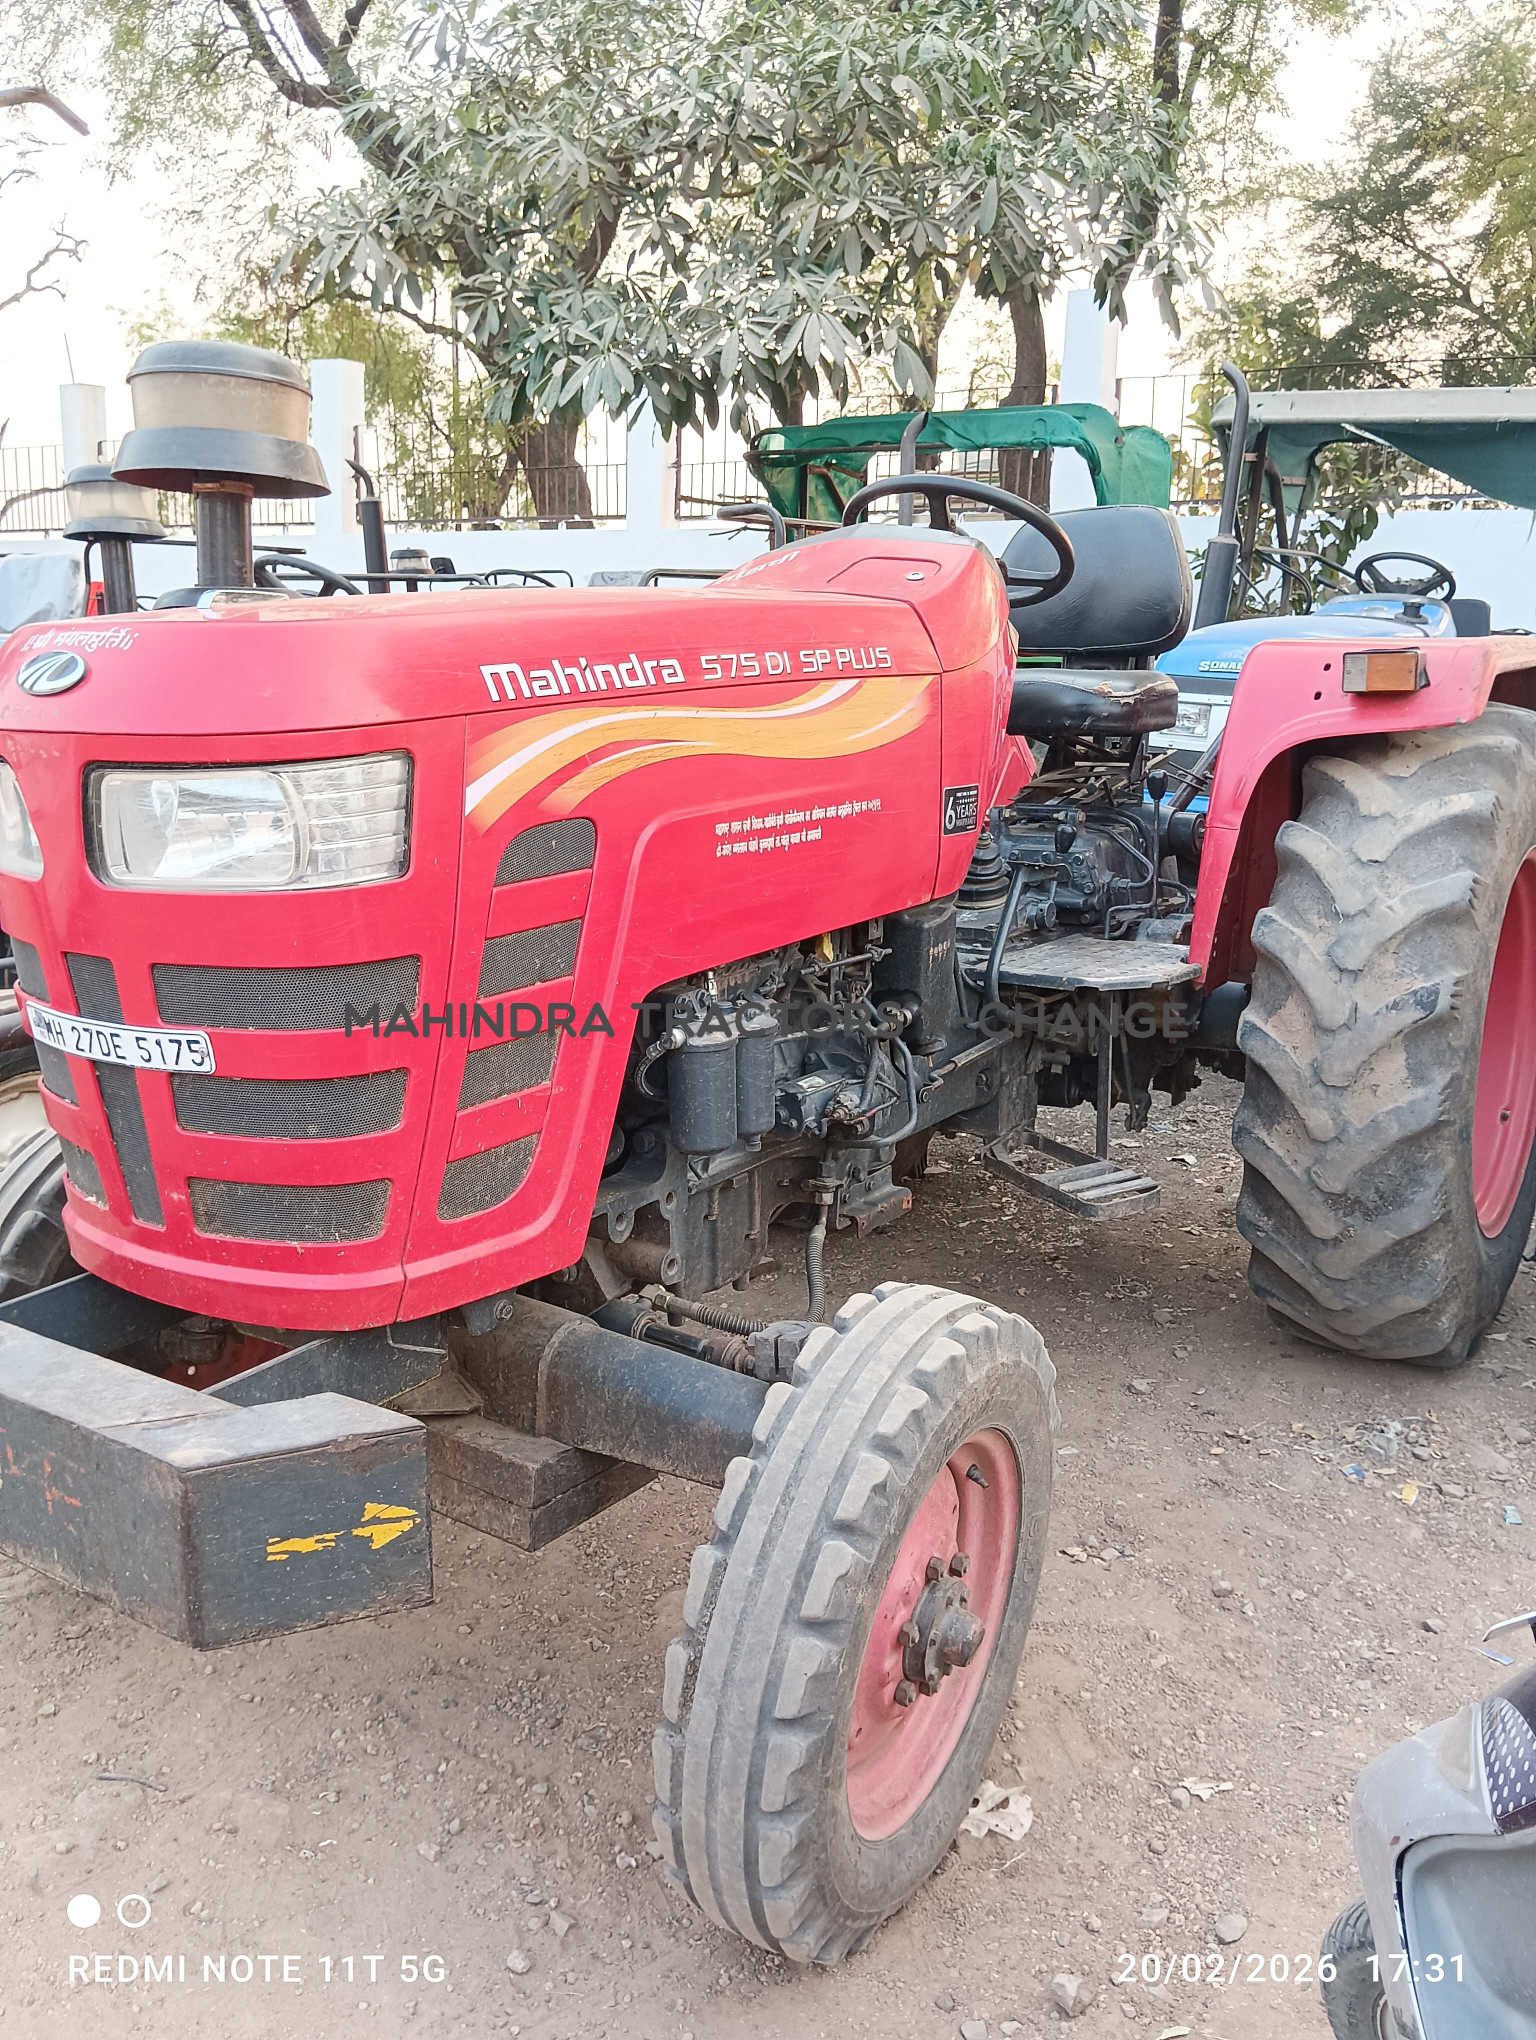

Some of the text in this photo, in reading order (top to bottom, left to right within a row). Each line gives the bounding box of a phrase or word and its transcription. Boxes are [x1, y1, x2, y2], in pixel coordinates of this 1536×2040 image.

[479, 647, 892, 702] Mahindra 575 DI SP PLUS
[945, 796, 977, 830] 6 YEARS
[44, 1017, 205, 1066] MH 27DE 5175
